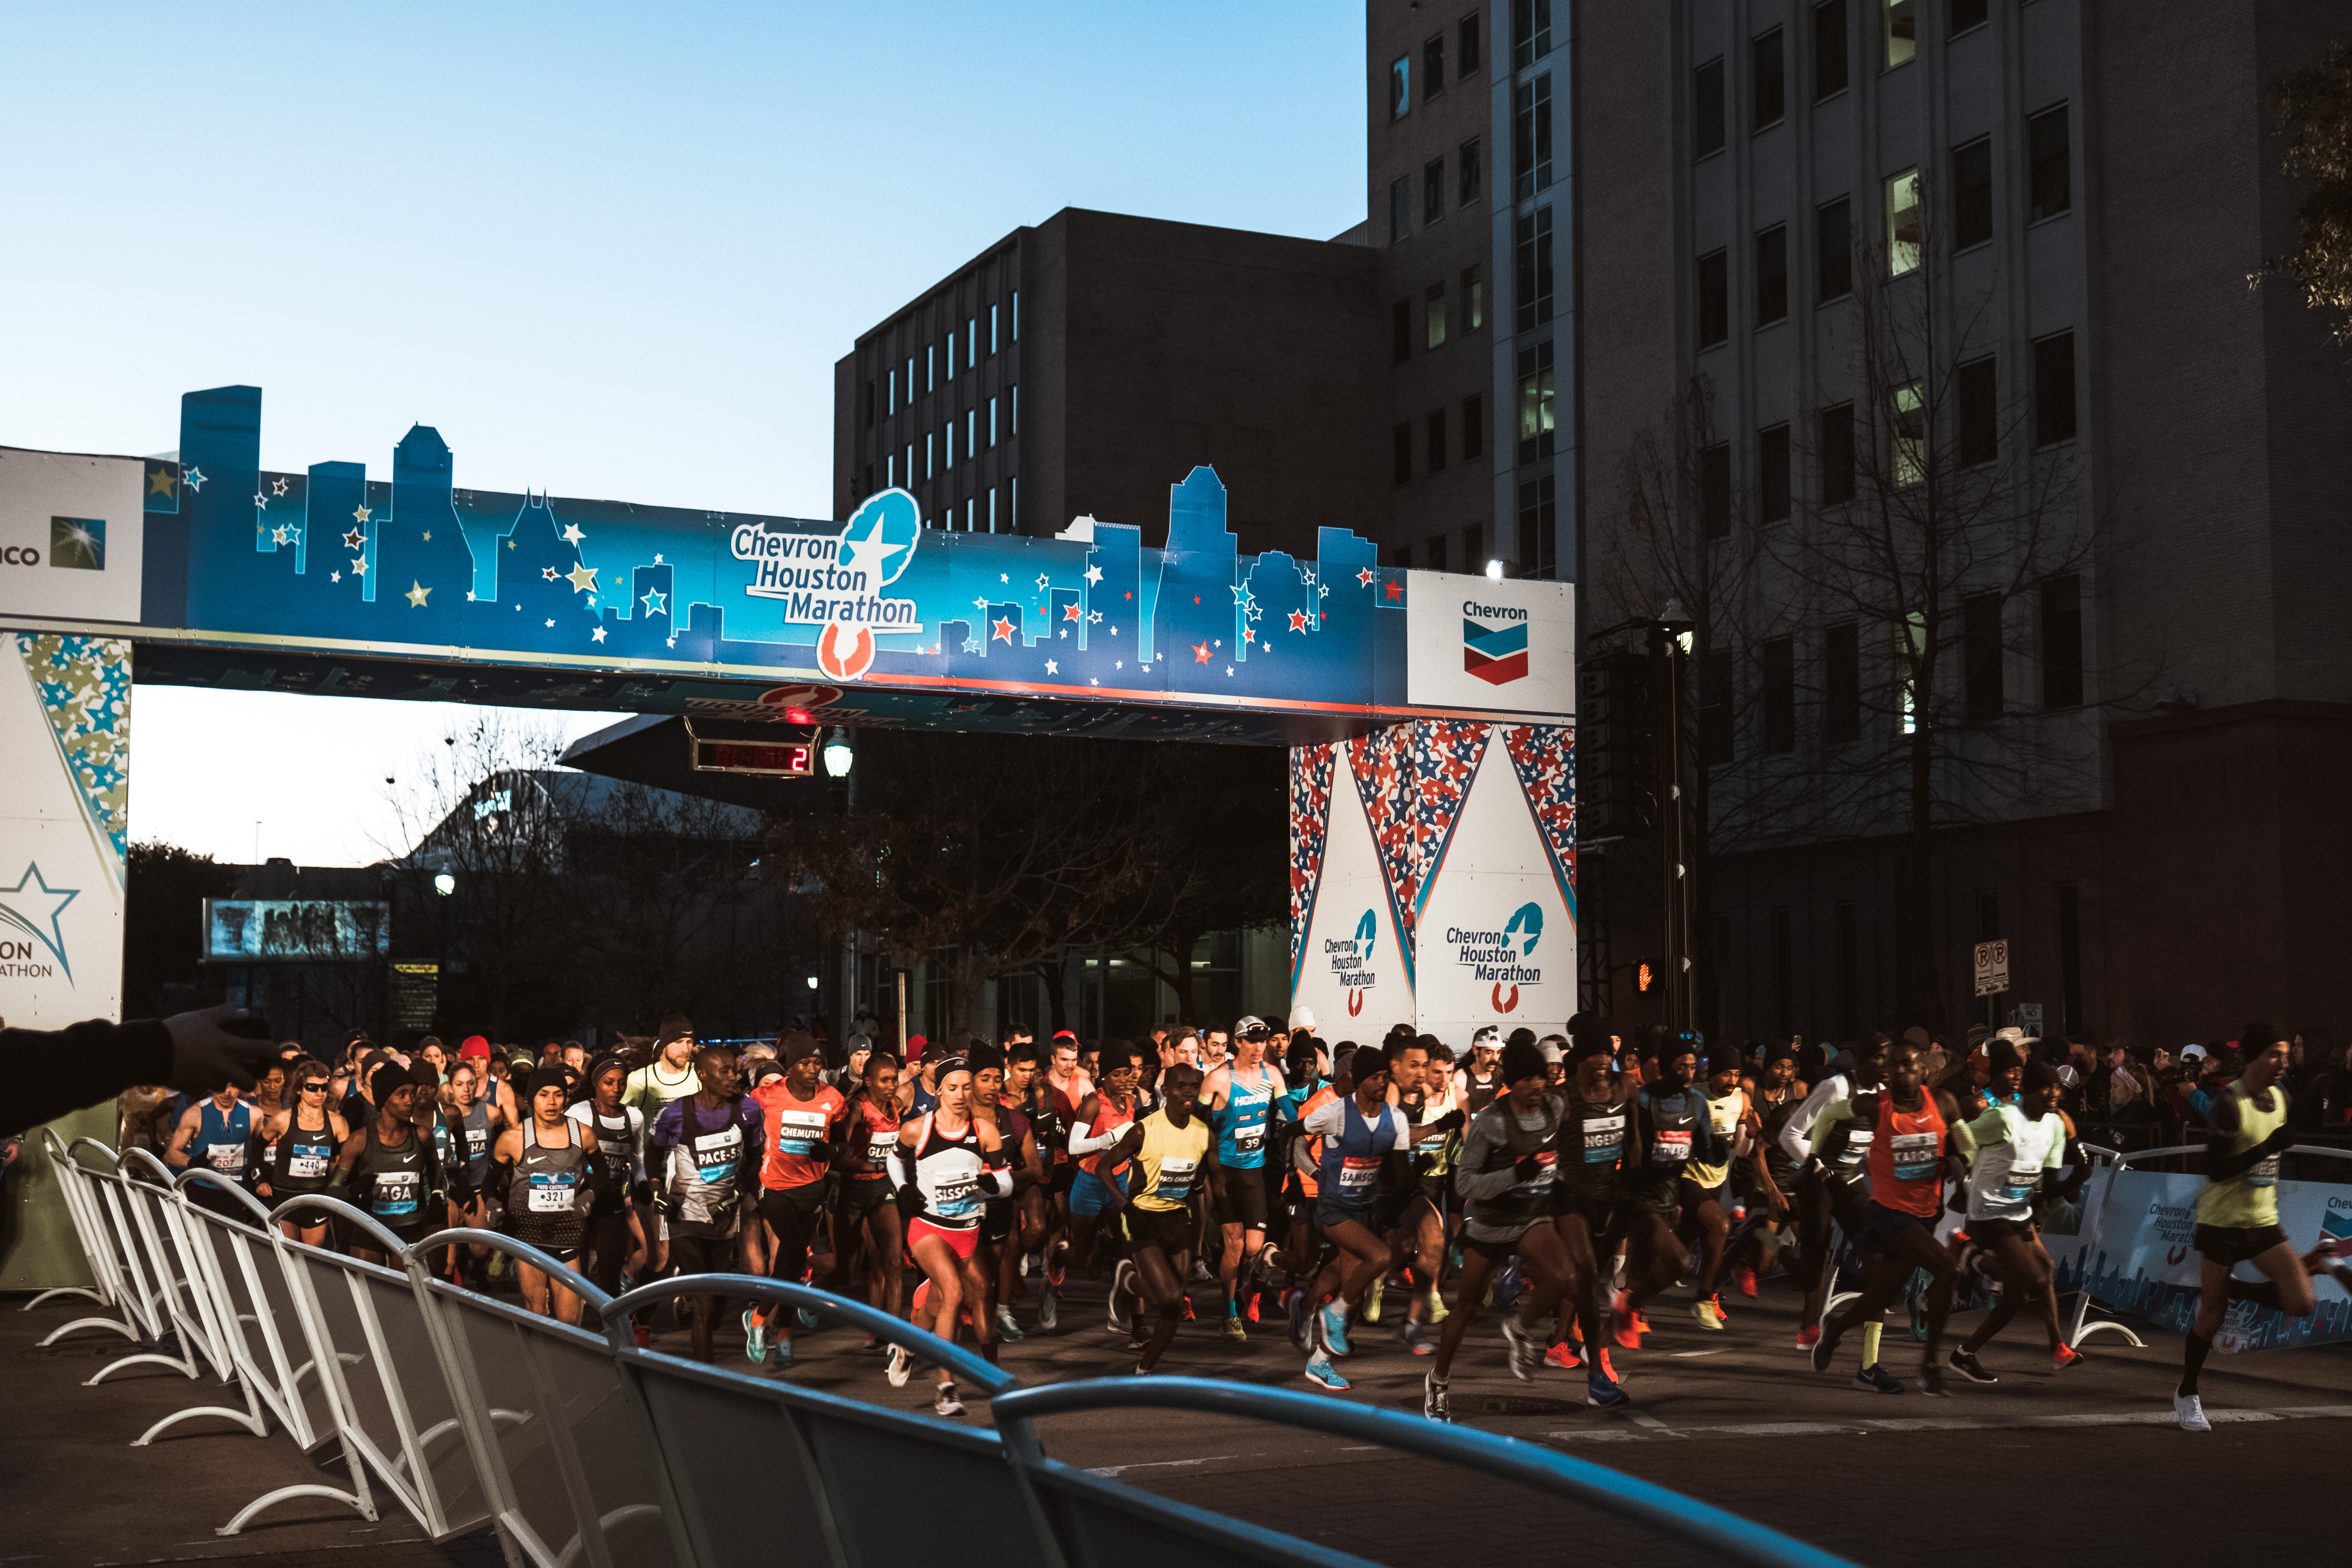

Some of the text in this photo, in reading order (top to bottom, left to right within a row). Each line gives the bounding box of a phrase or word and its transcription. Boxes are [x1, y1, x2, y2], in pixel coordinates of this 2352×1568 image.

[735, 529, 837, 559] Chevron
[0, 545, 40, 566] co
[760, 561, 867, 591] Houston
[789, 592, 913, 623] Marathon
[1463, 601, 1528, 620] Chevron
[792, 748, 807, 771] 2
[1447, 927, 1501, 945] Chevron
[1325, 938, 1353, 953] Chevron
[1460, 946, 1516, 963] Houston
[1332, 955, 1362, 970] Houston
[1340, 971, 1375, 986] Marathon
[1475, 964, 1541, 982] Marathon
[1245, 1138, 1259, 1149] 39
[216, 1159, 235, 1167] 207
[305, 1161, 319, 1169] 440
[379, 1186, 411, 1200] AGA
[546, 1192, 563, 1201] 321
[2149, 1203, 2186, 1216] Chevron
[2154, 1216, 2193, 1230] Houston
